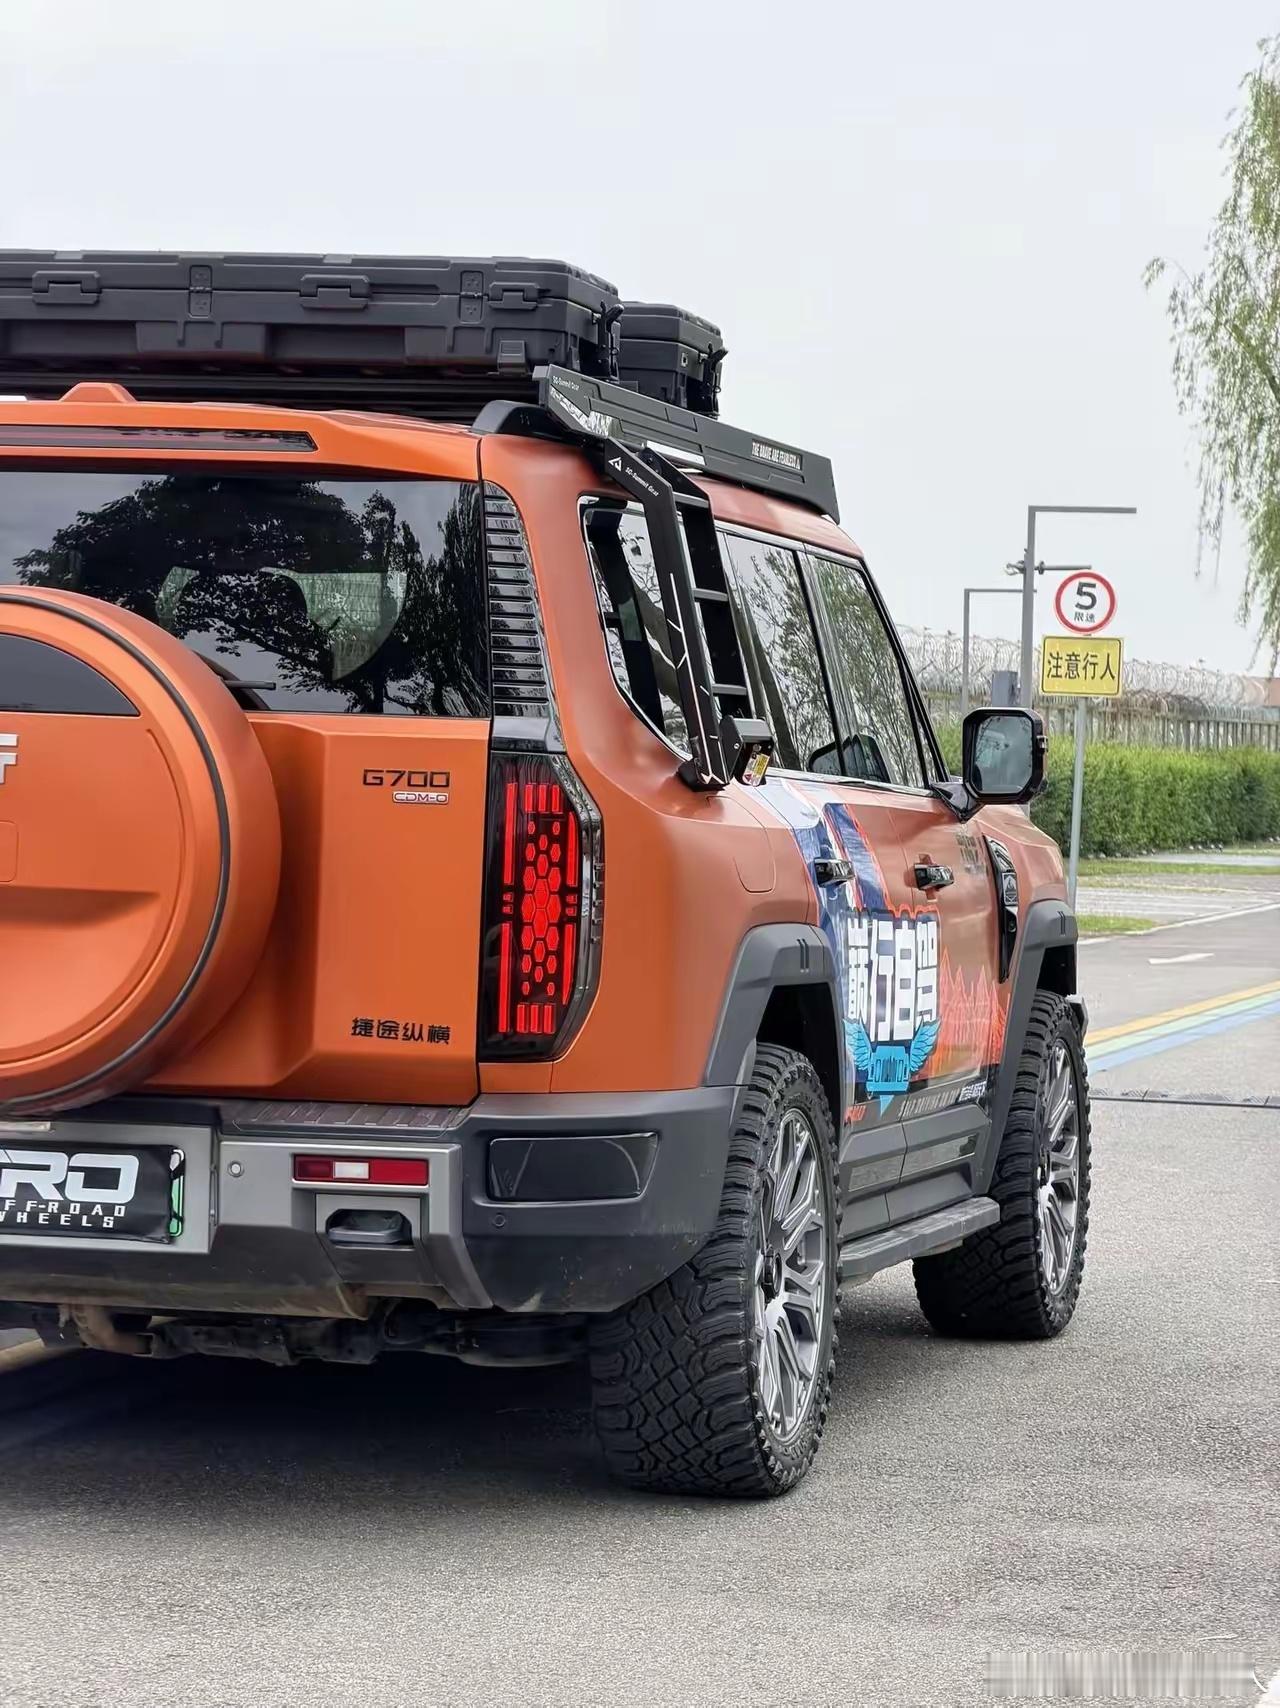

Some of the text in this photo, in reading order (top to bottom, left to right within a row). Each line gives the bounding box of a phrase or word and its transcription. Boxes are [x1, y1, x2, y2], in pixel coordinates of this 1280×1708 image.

[625, 467, 659, 497] SG-Summit Gear
[1075, 581, 1098, 610] 5
[1073, 612, 1096, 623] 限速
[1046, 652, 1116, 680] 注意行人
[363, 769, 450, 788] G700
[393, 793, 448, 803] CDM-O
[351, 1018, 451, 1045] 捷途纵横
[0, 1149, 139, 1204] RO
